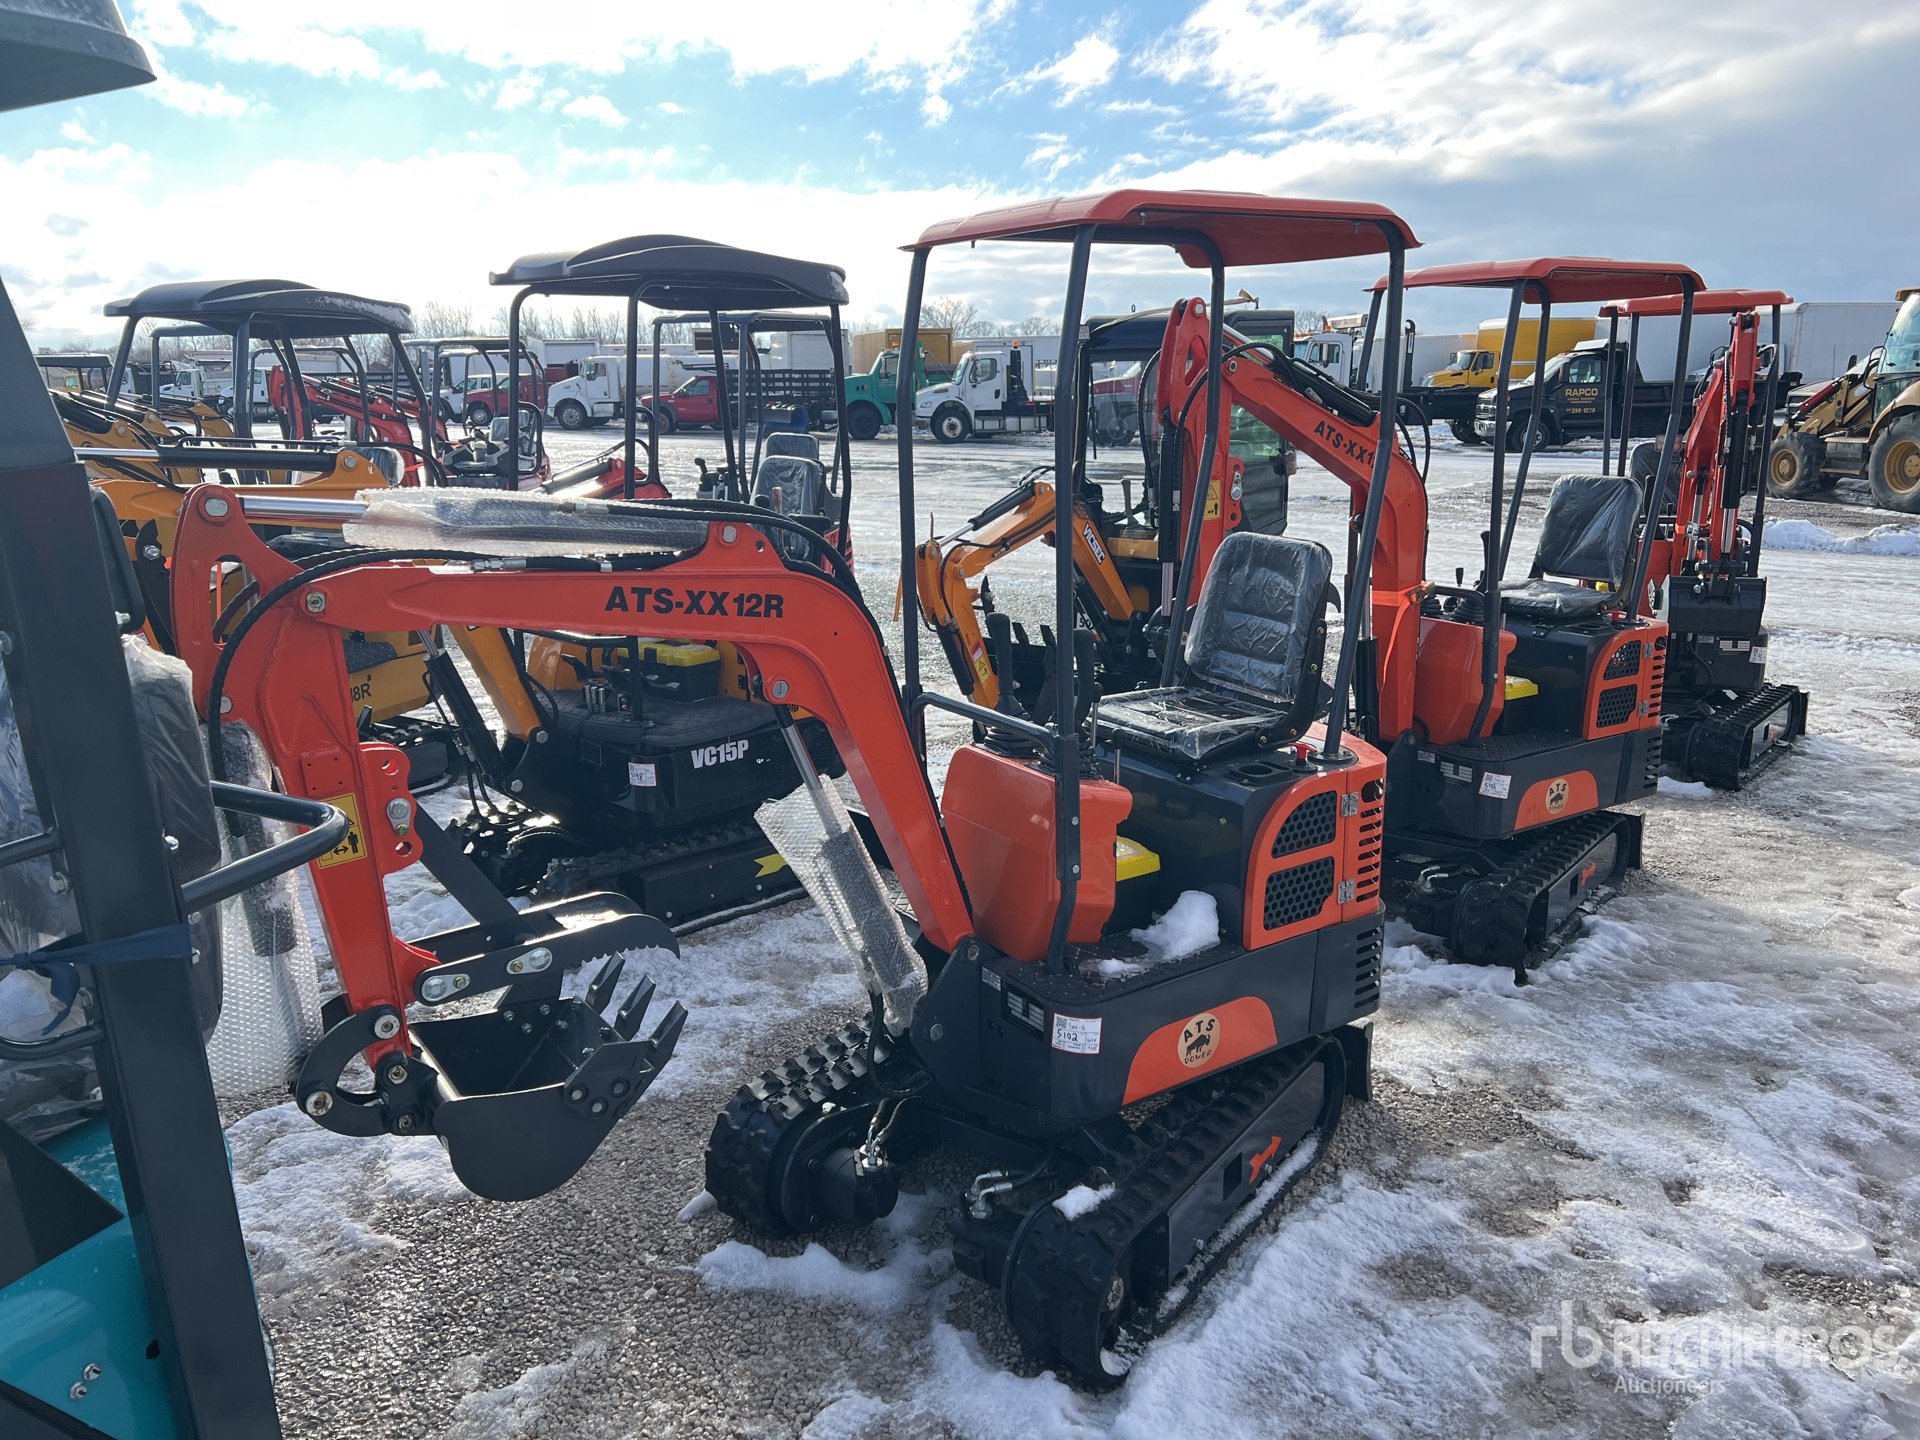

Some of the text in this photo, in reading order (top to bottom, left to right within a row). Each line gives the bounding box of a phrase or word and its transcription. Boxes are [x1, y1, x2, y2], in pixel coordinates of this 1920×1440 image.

[1565, 388, 1599, 397] RAPCO
[1314, 420, 1390, 470] ATS-XX1
[605, 586, 784, 619] ATS-XX12R
[690, 739, 749, 769] VC15P
[1549, 783, 1567, 797] ATS
[1057, 1028, 1078, 1043] 5102
[1183, 1018, 1216, 1044] ATS
[1184, 1049, 1212, 1065] POWER
